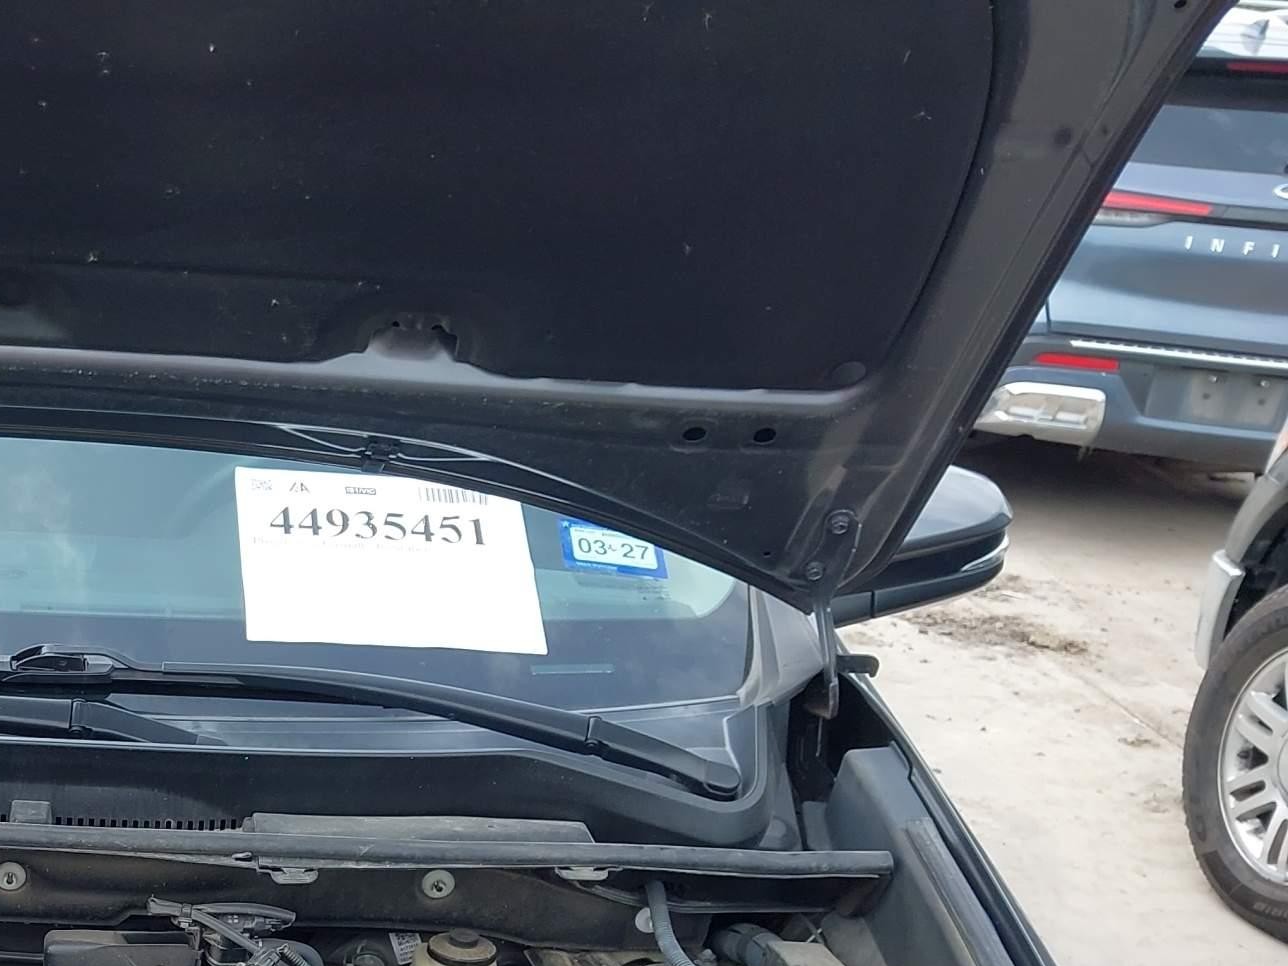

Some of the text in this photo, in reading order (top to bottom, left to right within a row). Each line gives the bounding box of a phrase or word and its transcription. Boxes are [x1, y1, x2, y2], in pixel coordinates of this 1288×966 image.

[269, 506, 486, 546] 44935451
[578, 538, 649, 560] 03 27
